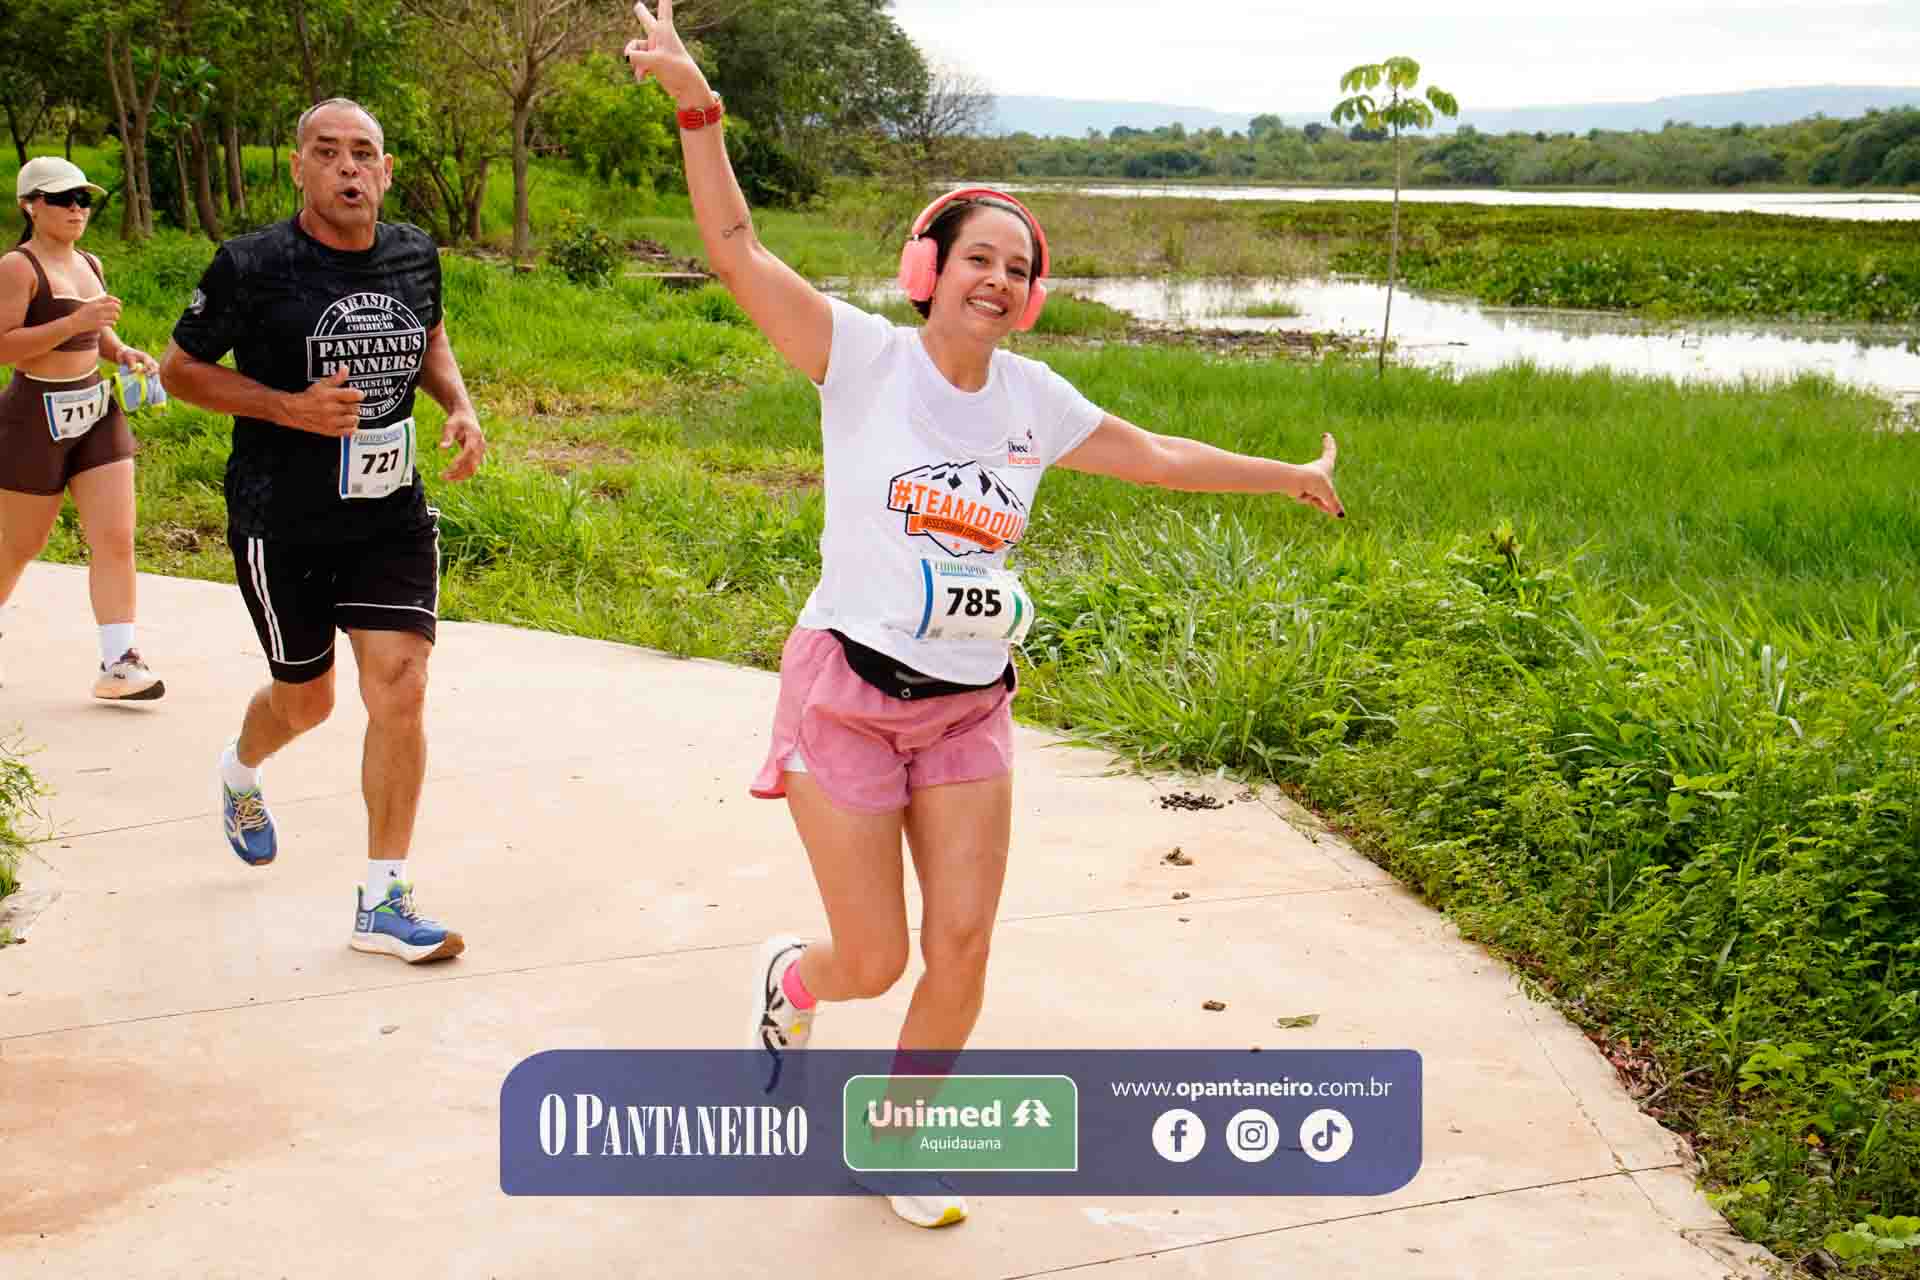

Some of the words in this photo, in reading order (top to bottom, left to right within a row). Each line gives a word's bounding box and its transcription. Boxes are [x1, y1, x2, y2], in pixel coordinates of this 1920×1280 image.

[337, 295, 393, 313] BRASIL
[319, 334, 421, 357] PANTANUS
[62, 402, 94, 422] 711
[361, 448, 399, 475] 727
[946, 587, 1002, 617] 785
